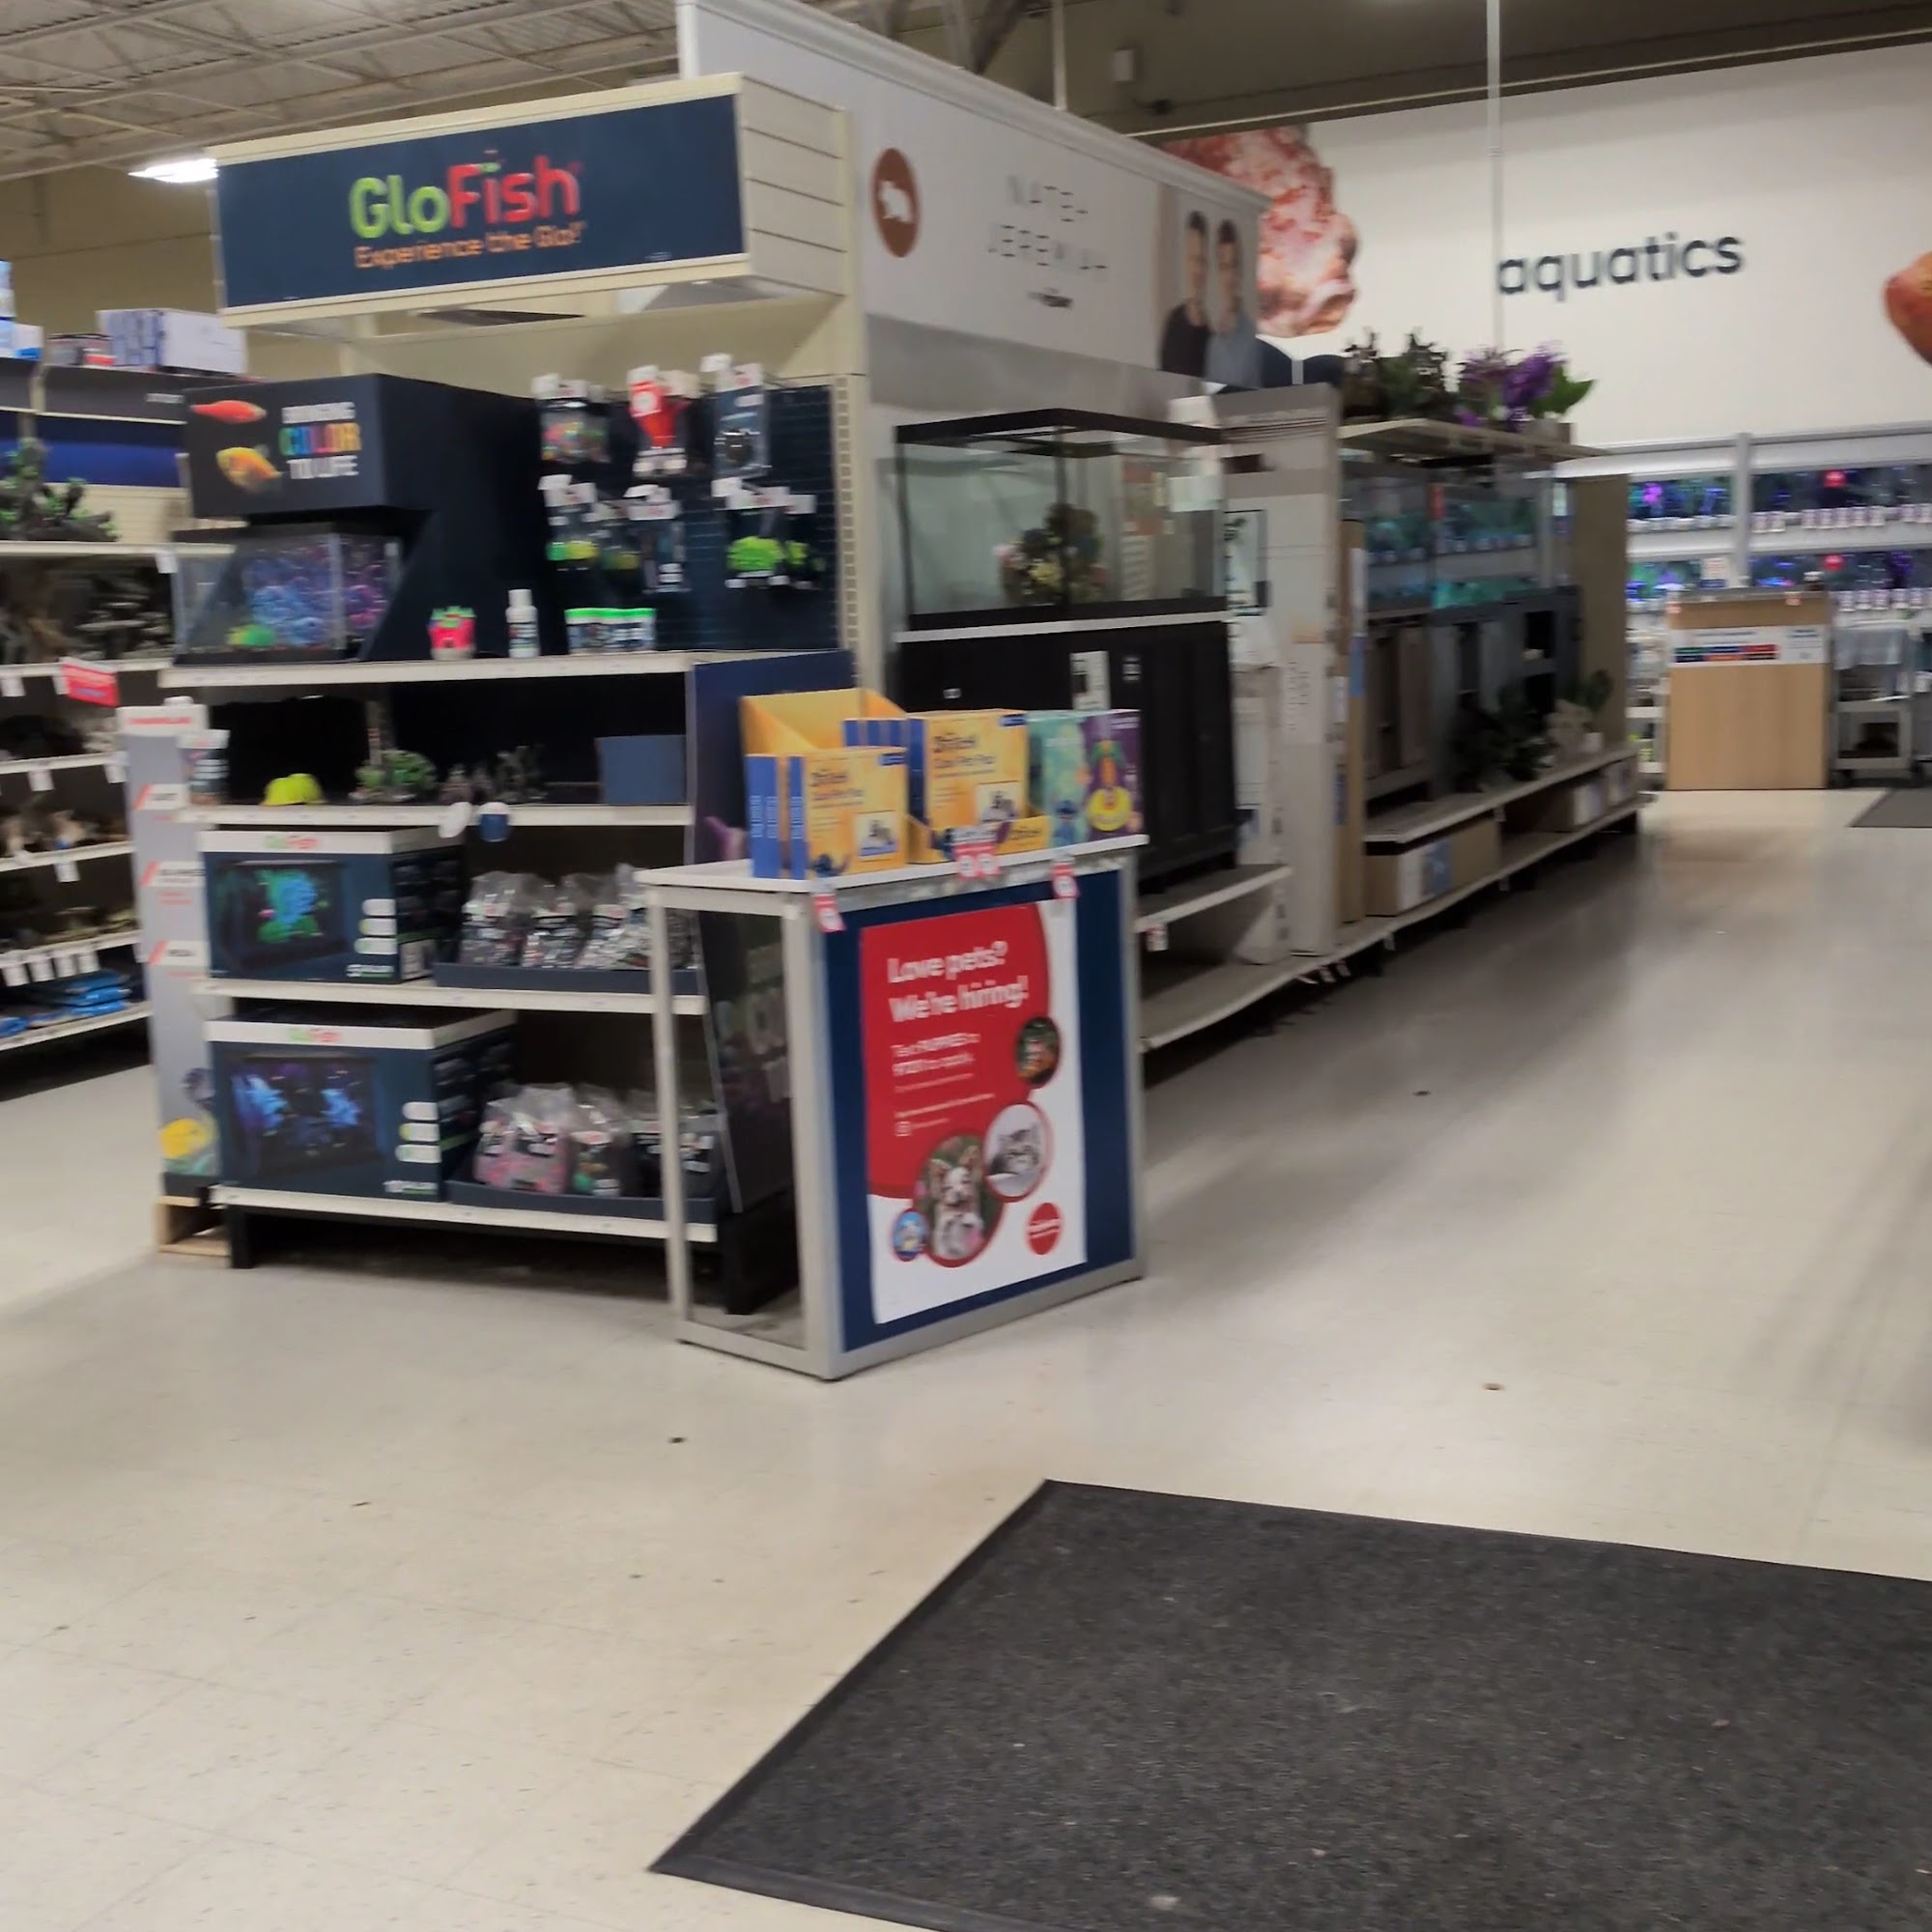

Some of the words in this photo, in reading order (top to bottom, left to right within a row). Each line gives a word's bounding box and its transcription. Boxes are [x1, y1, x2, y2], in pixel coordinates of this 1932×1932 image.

[350, 155, 580, 240] GloFish
[354, 241, 483, 270] Experience
[485, 231, 531, 253] the
[1497, 232, 1745, 302] aquatics
[278, 422, 362, 457] COLOR
[887, 957, 945, 983] Love
[945, 940, 1009, 980] pets?
[888, 991, 957, 1022] We're
[957, 975, 1030, 1009] hiring!
